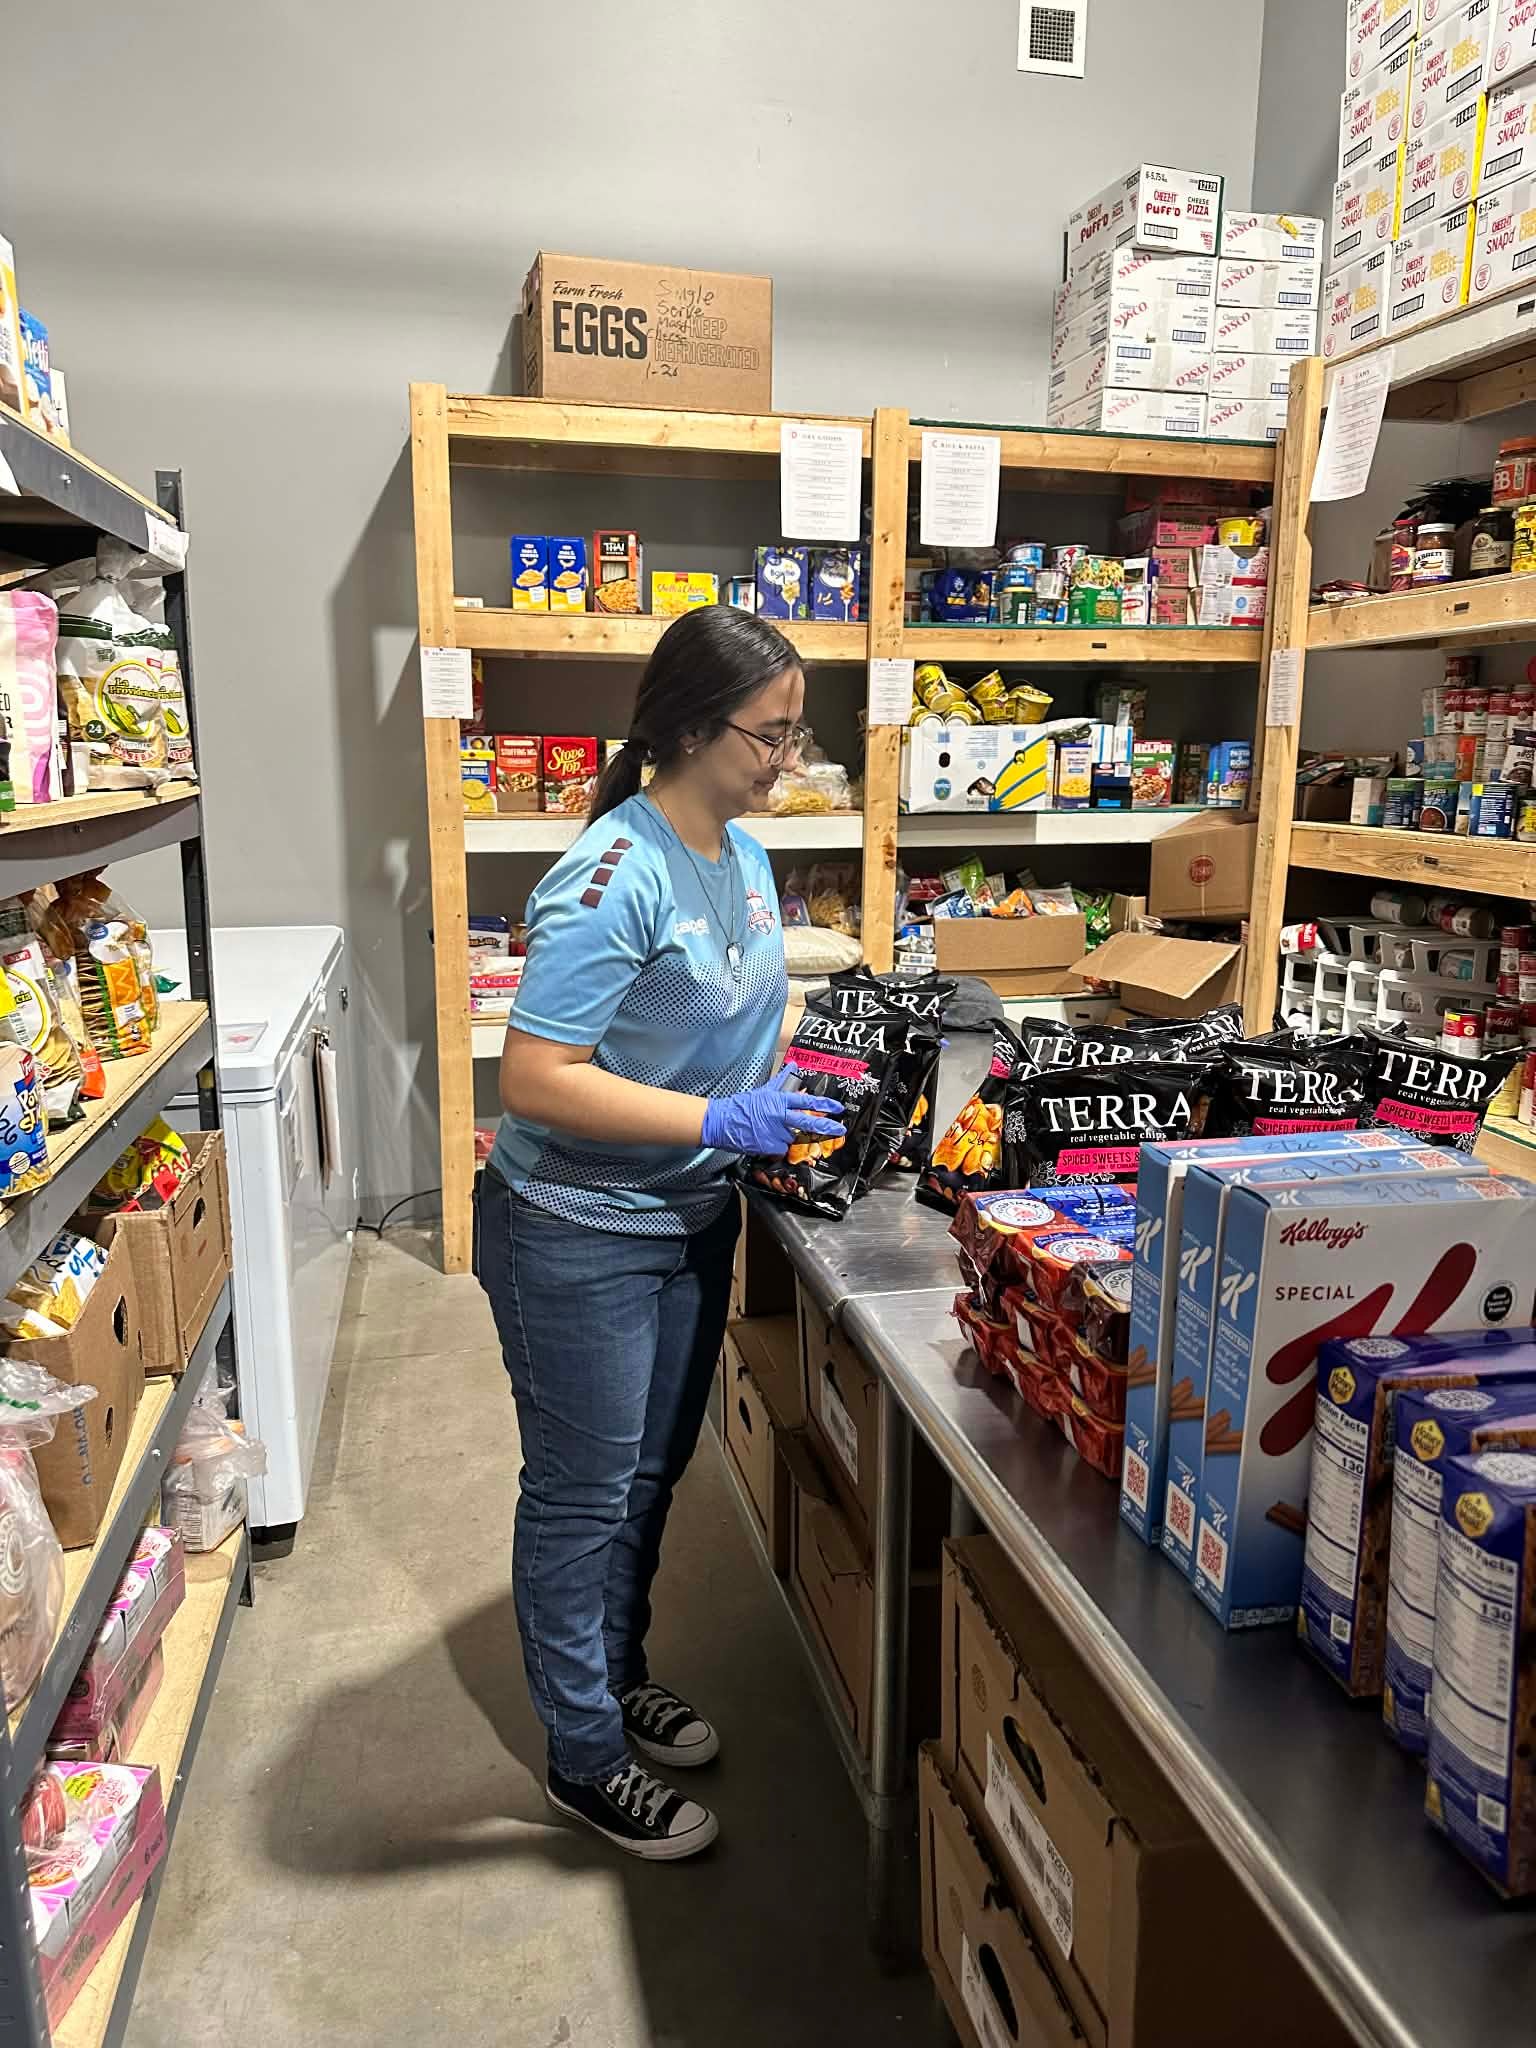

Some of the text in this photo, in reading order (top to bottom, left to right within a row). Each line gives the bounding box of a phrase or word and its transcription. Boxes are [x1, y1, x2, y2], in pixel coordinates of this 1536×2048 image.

[1187, 196, 1210, 205] CHEESE
[1187, 203, 1209, 216] PIZZA
[1225, 217, 1258, 242] SYSCO
[1117, 253, 1152, 278] SYSCO
[1221, 265, 1255, 290] SYSCO
[552, 281, 624, 301] Farm Fresh
[654, 279, 715, 306] Single
[1113, 301, 1148, 326] SYSCO
[1218, 312, 1251, 337] SYSCO
[553, 300, 648, 360] EGGS
[690, 316, 727, 340] KEEP
[654, 341, 760, 370] REFRIGERATED
[1212, 357, 1245, 382] SYSCO
[1209, 402, 1244, 427] SYSCO
[604, 542, 625, 552] THAI
[87, 723, 104, 734] 24
[547, 746, 586, 770] Stove
[1134, 744, 1172, 753] HELPER
[561, 761, 580, 776] Top
[792, 1014, 887, 1054] TERRA
[812, 1040, 843, 1052] vegetable
[845, 1047, 861, 1055] chips
[1242, 1069, 1366, 1105] TERRA
[1398, 1089, 1418, 1100] real
[1040, 1090, 1192, 1132] TERRA
[1269, 1106, 1289, 1114] real
[1290, 1107, 1329, 1116] vegetable
[1383, 1103, 1415, 1121] SPICED
[1070, 1128, 1167, 1144] real vegetable chips
[1062, 1153, 1091, 1166] SPICED
[1093, 1151, 1127, 1165] SWEETS
[1045, 1188, 1067, 1196] ZERO
[1135, 1217, 1162, 1264] K
[1279, 1218, 1367, 1249] Kellogg's
[1179, 1246, 1213, 1292] K
[1220, 1272, 1256, 1320] K
[1275, 1284, 1355, 1301] SPECIAL
[1340, 1414, 1366, 1435] Facts
[1343, 1457, 1363, 1474] 130
[1475, 1551, 1515, 1575] Facts
[1480, 1602, 1513, 1623] 130
